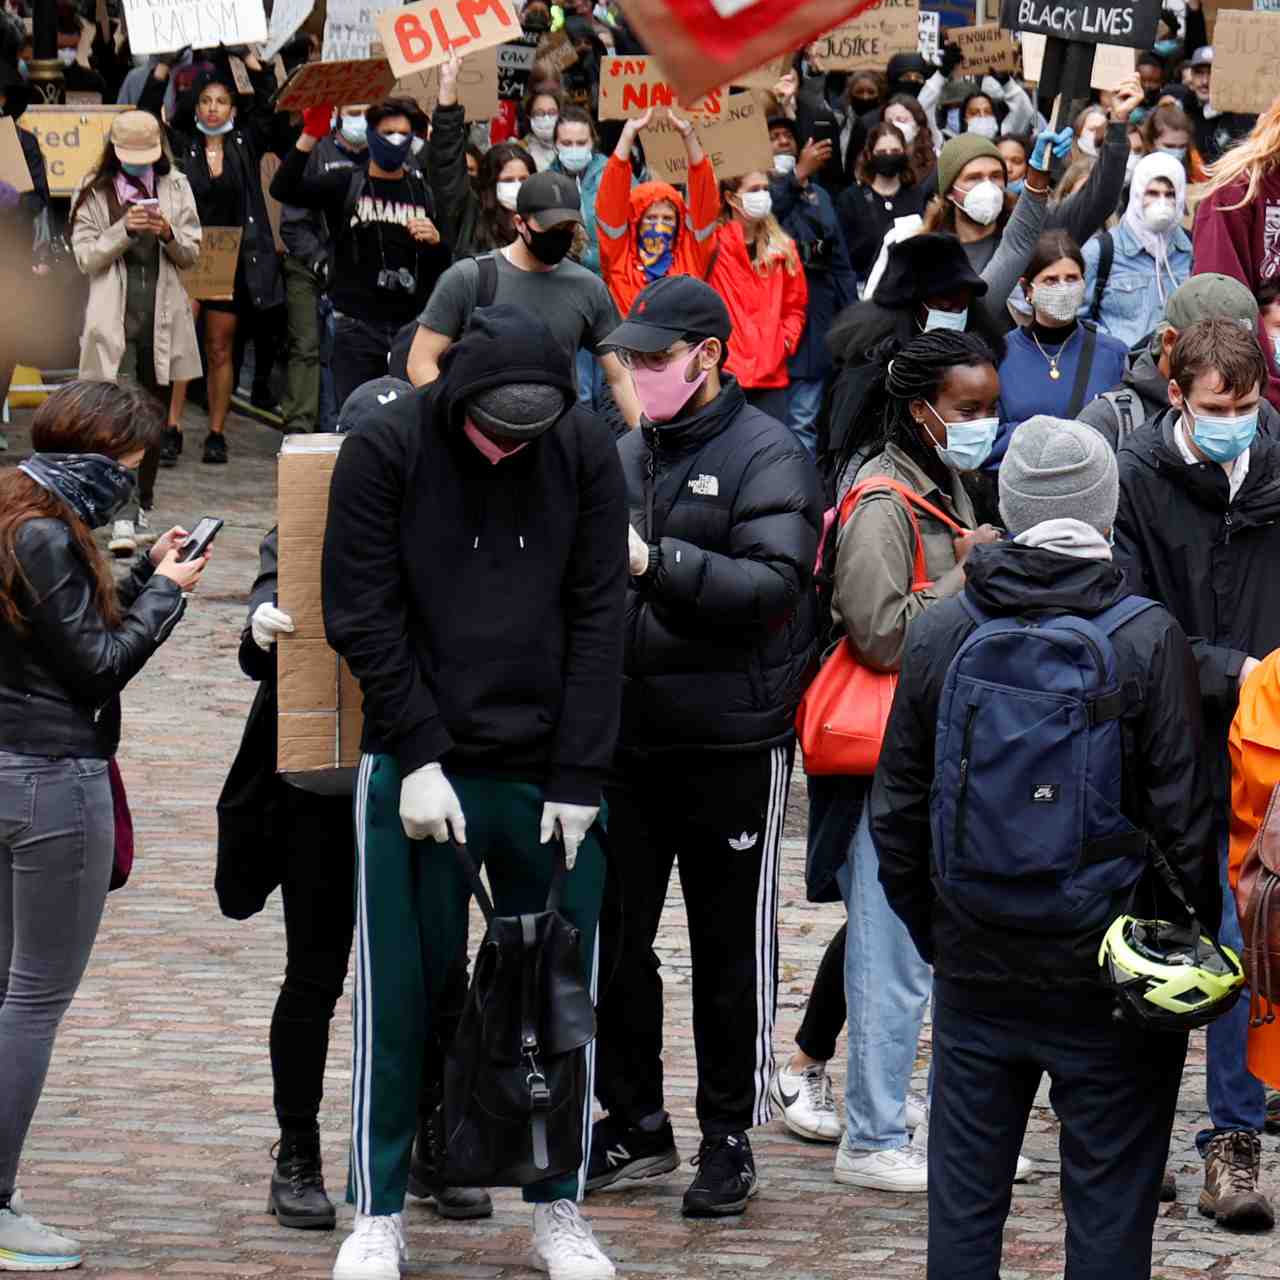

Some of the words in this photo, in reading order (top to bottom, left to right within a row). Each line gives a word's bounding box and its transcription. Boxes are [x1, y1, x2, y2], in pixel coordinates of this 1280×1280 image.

[152, 0, 241, 47] RACISM
[1018, 0, 1076, 32] BLACK
[1081, 6, 1134, 35] LIVES
[817, 37, 879, 59] JUSTICE
[610, 60, 647, 77] SAY
